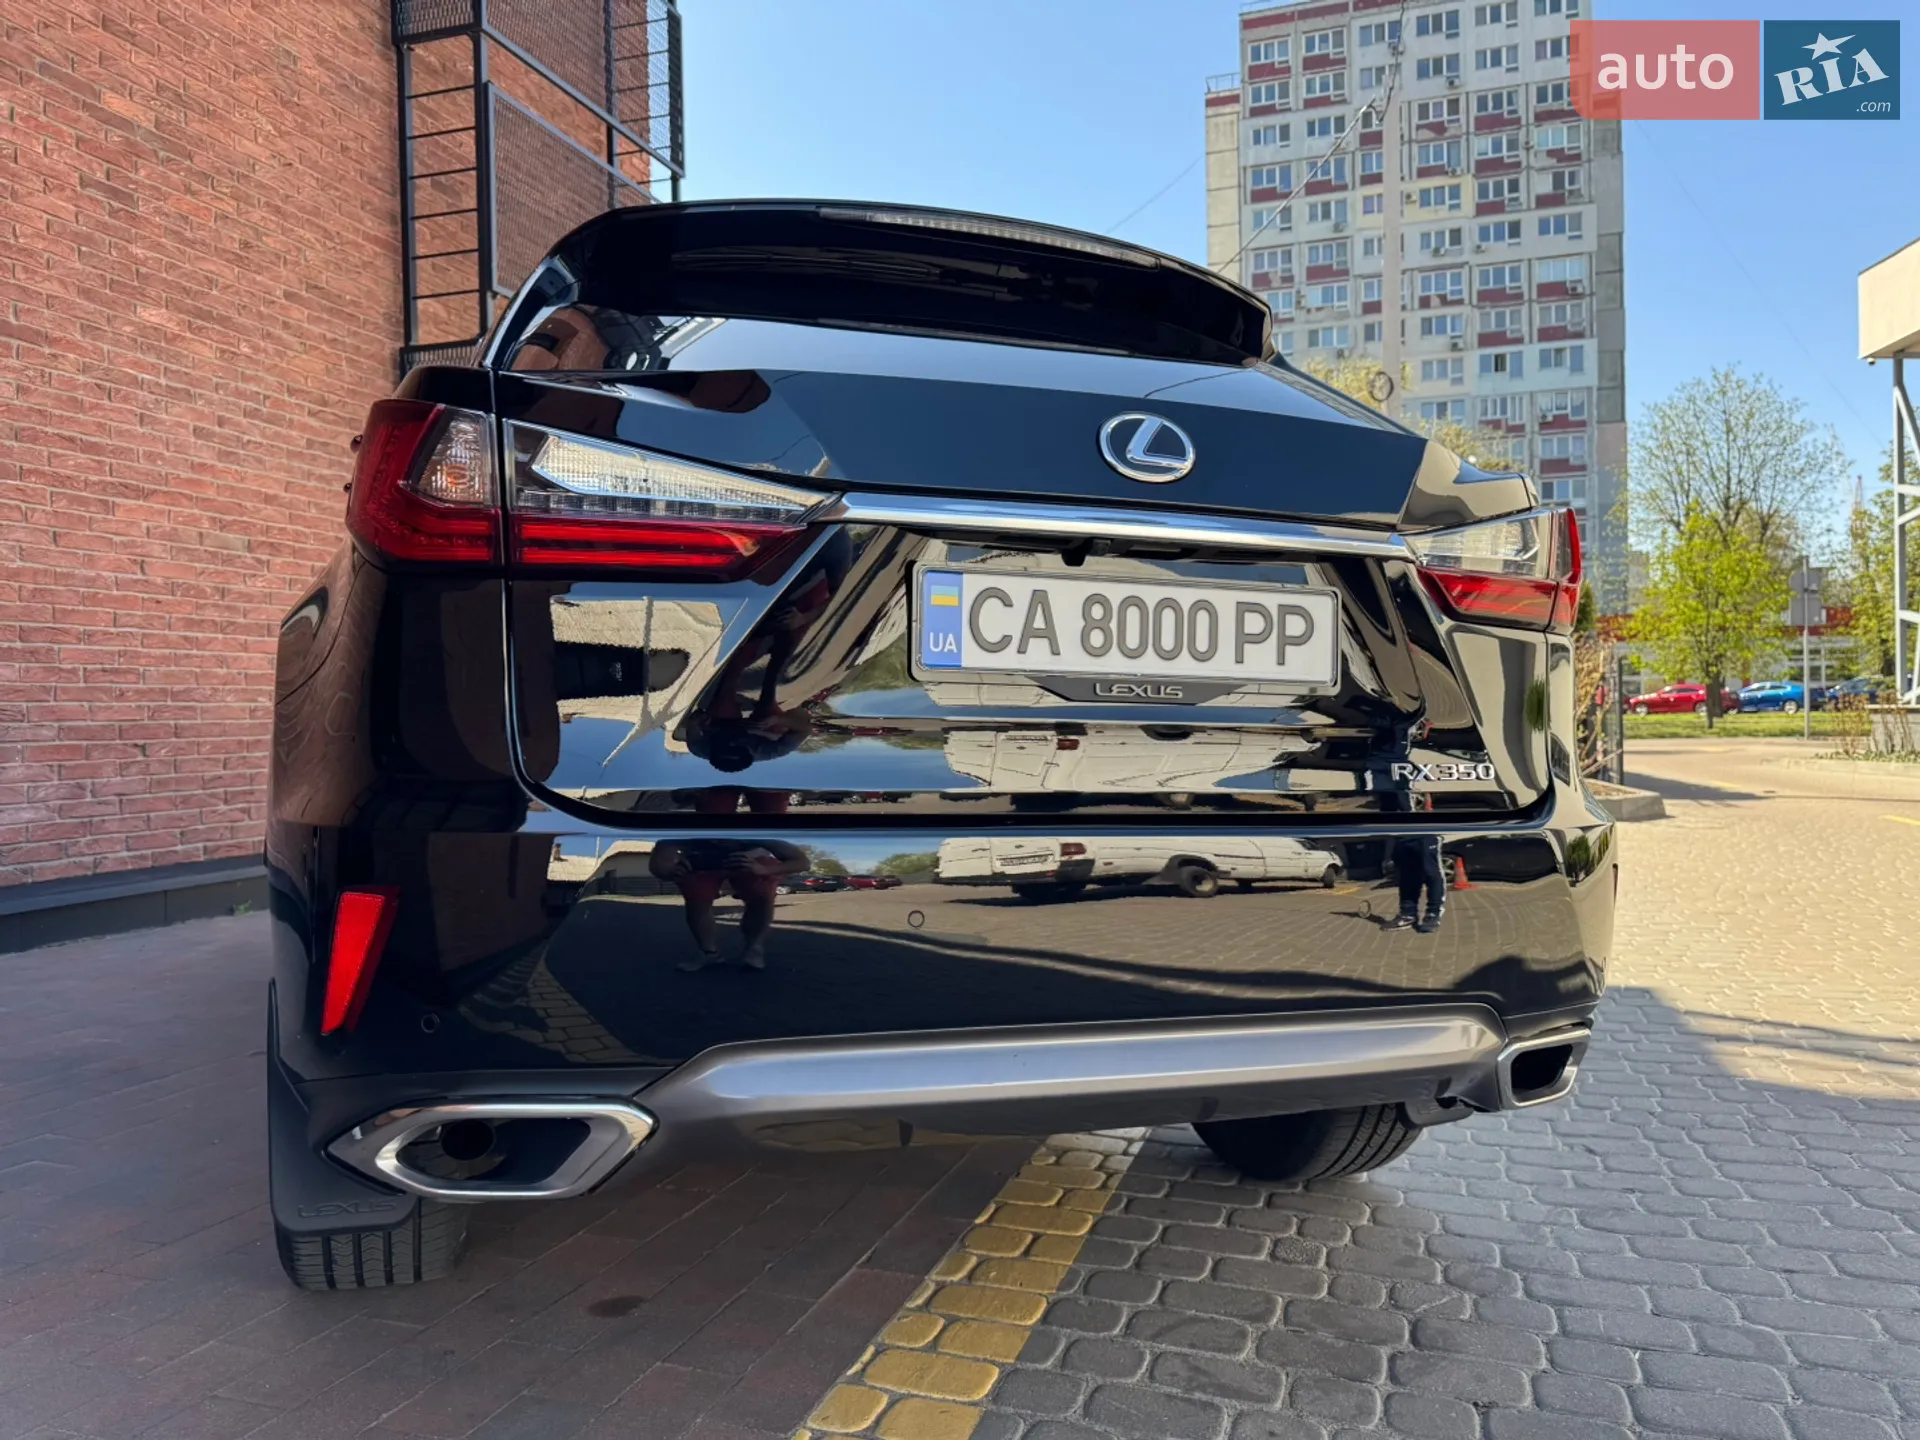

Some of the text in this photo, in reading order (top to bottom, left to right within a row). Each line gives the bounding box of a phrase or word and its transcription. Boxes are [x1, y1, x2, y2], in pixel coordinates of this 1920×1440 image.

[969, 587, 1314, 665] CA 8000 PP
[929, 633, 958, 654] UA
[1095, 683, 1183, 699] LEXUS
[298, 1200, 397, 1219] LEXUS
